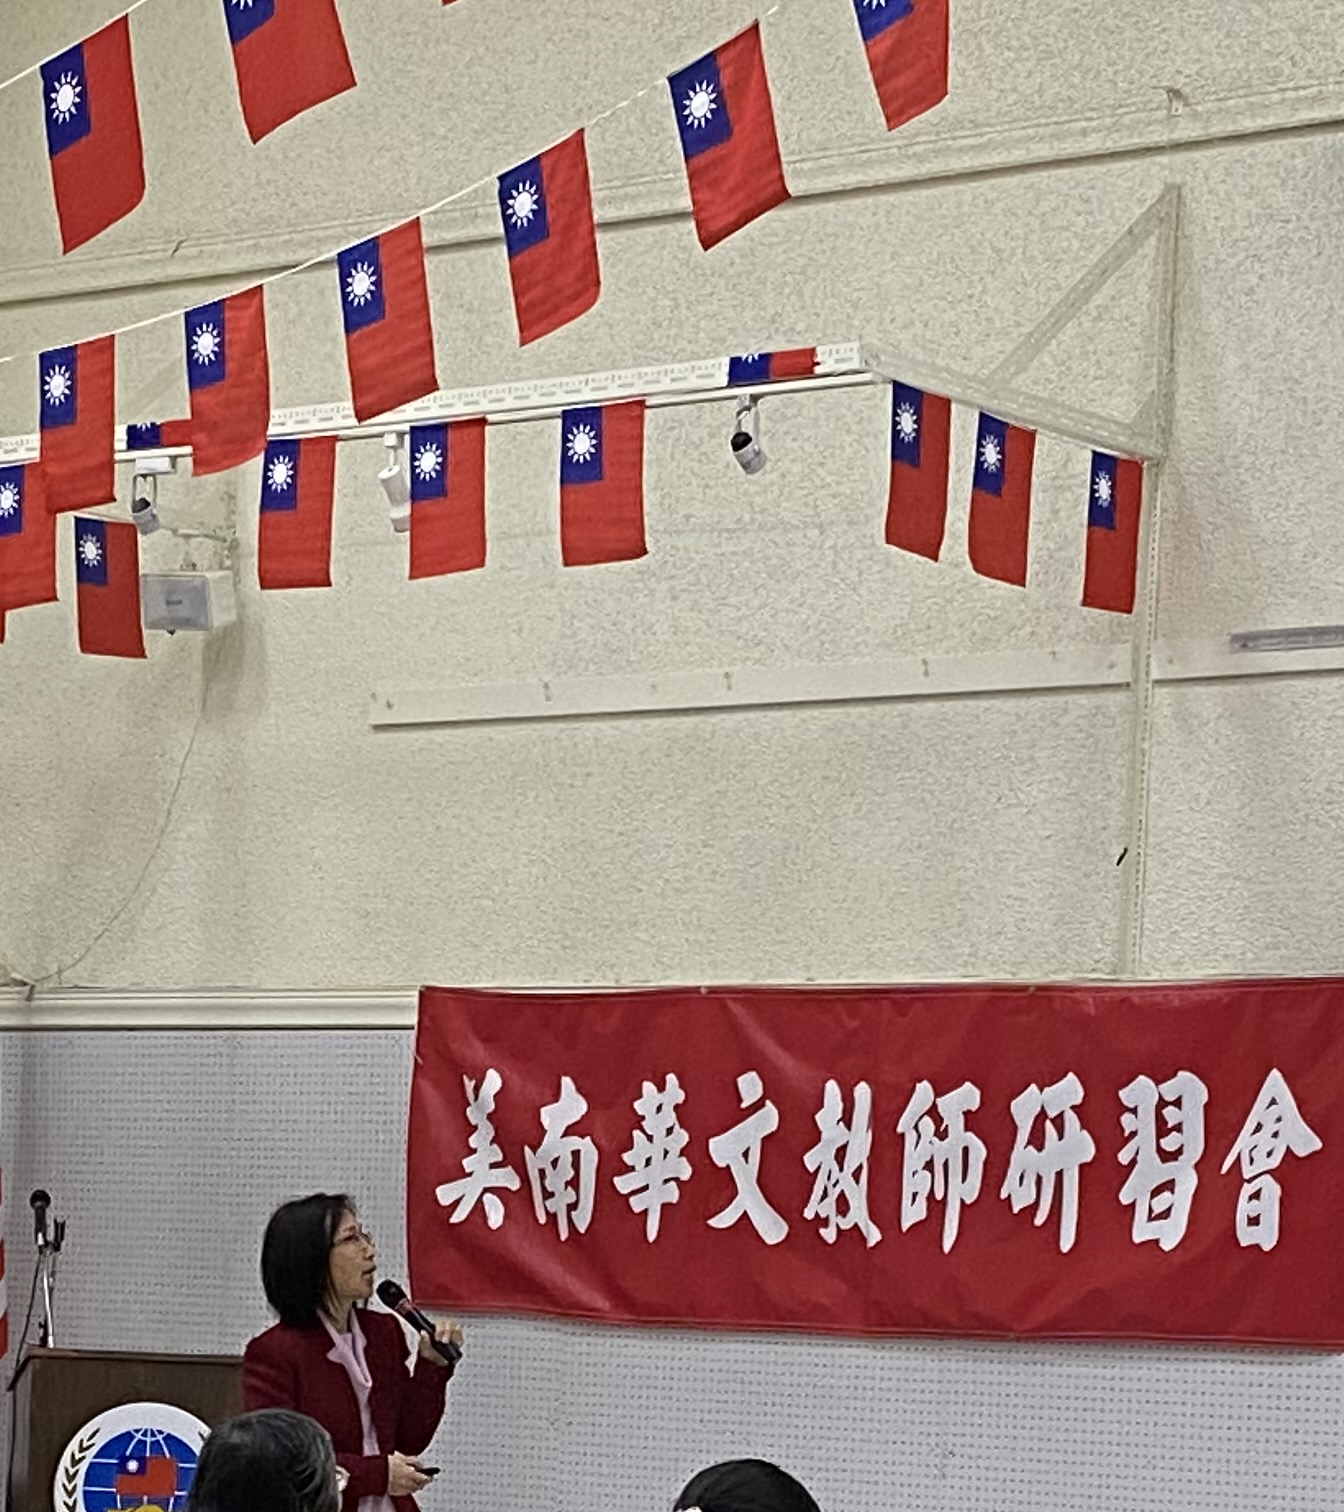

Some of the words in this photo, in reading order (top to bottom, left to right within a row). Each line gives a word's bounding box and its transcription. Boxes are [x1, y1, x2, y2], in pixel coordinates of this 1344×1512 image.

[433, 1066, 1323, 1254] 美南華文教師研習會
